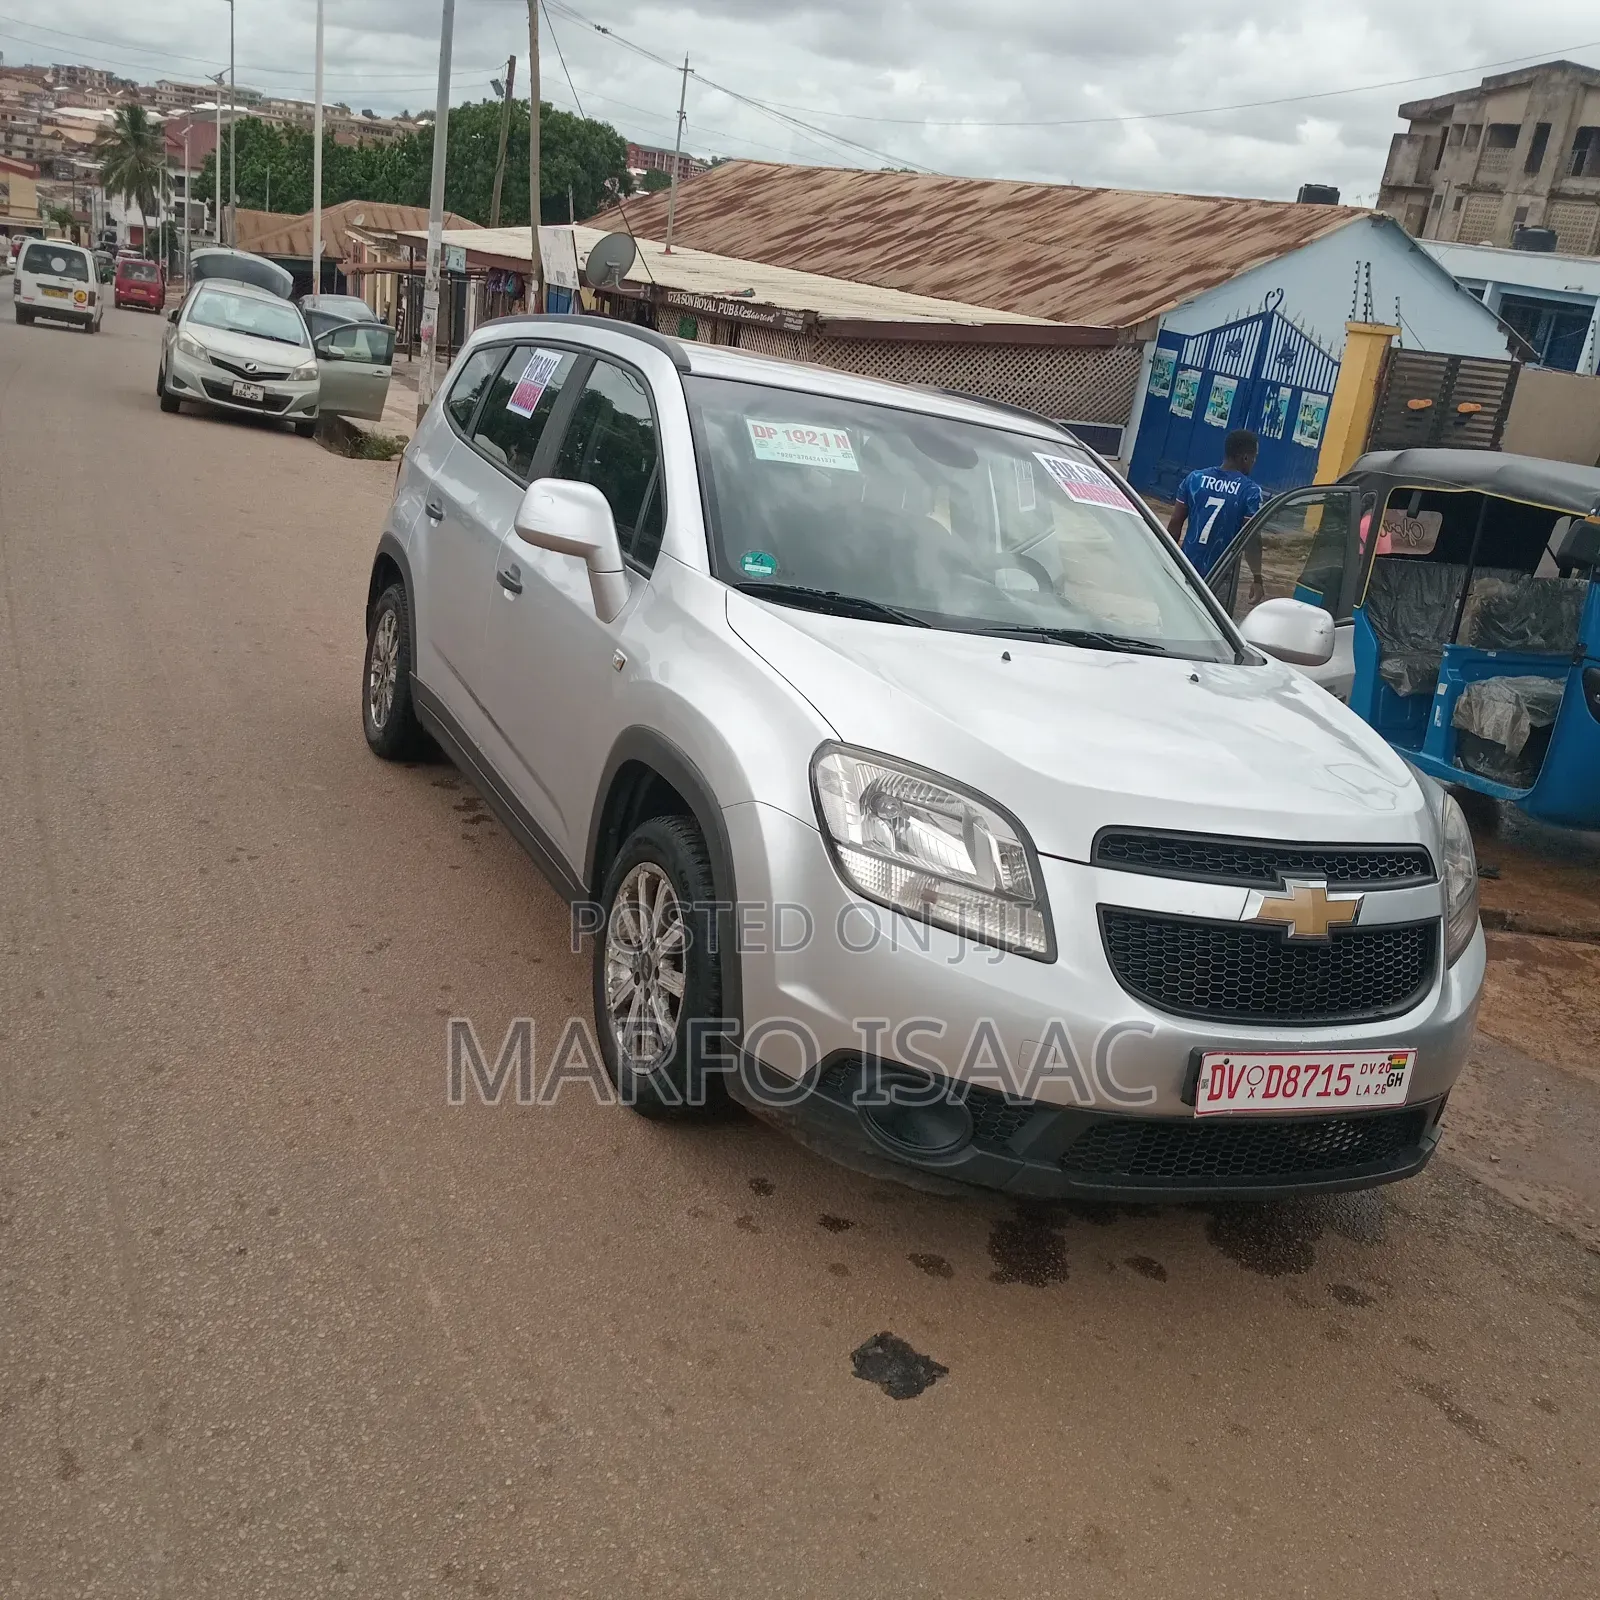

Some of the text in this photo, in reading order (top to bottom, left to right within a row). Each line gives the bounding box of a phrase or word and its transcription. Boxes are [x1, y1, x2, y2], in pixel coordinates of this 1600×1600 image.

[693, 296, 717, 312] ROYAL
[717, 302, 735, 316] PUB
[751, 424, 778, 440] DP
[782, 429, 831, 448] 1921
[833, 433, 850, 450] N
[1043, 458, 1084, 481] FOR
[1198, 496, 1226, 545] 7
[1360, 1062, 1392, 1075] DV 20
[1207, 1063, 1355, 1101] DV D8715
[1356, 1083, 1387, 1096] LA 26
[1386, 1072, 1404, 1087] GH
